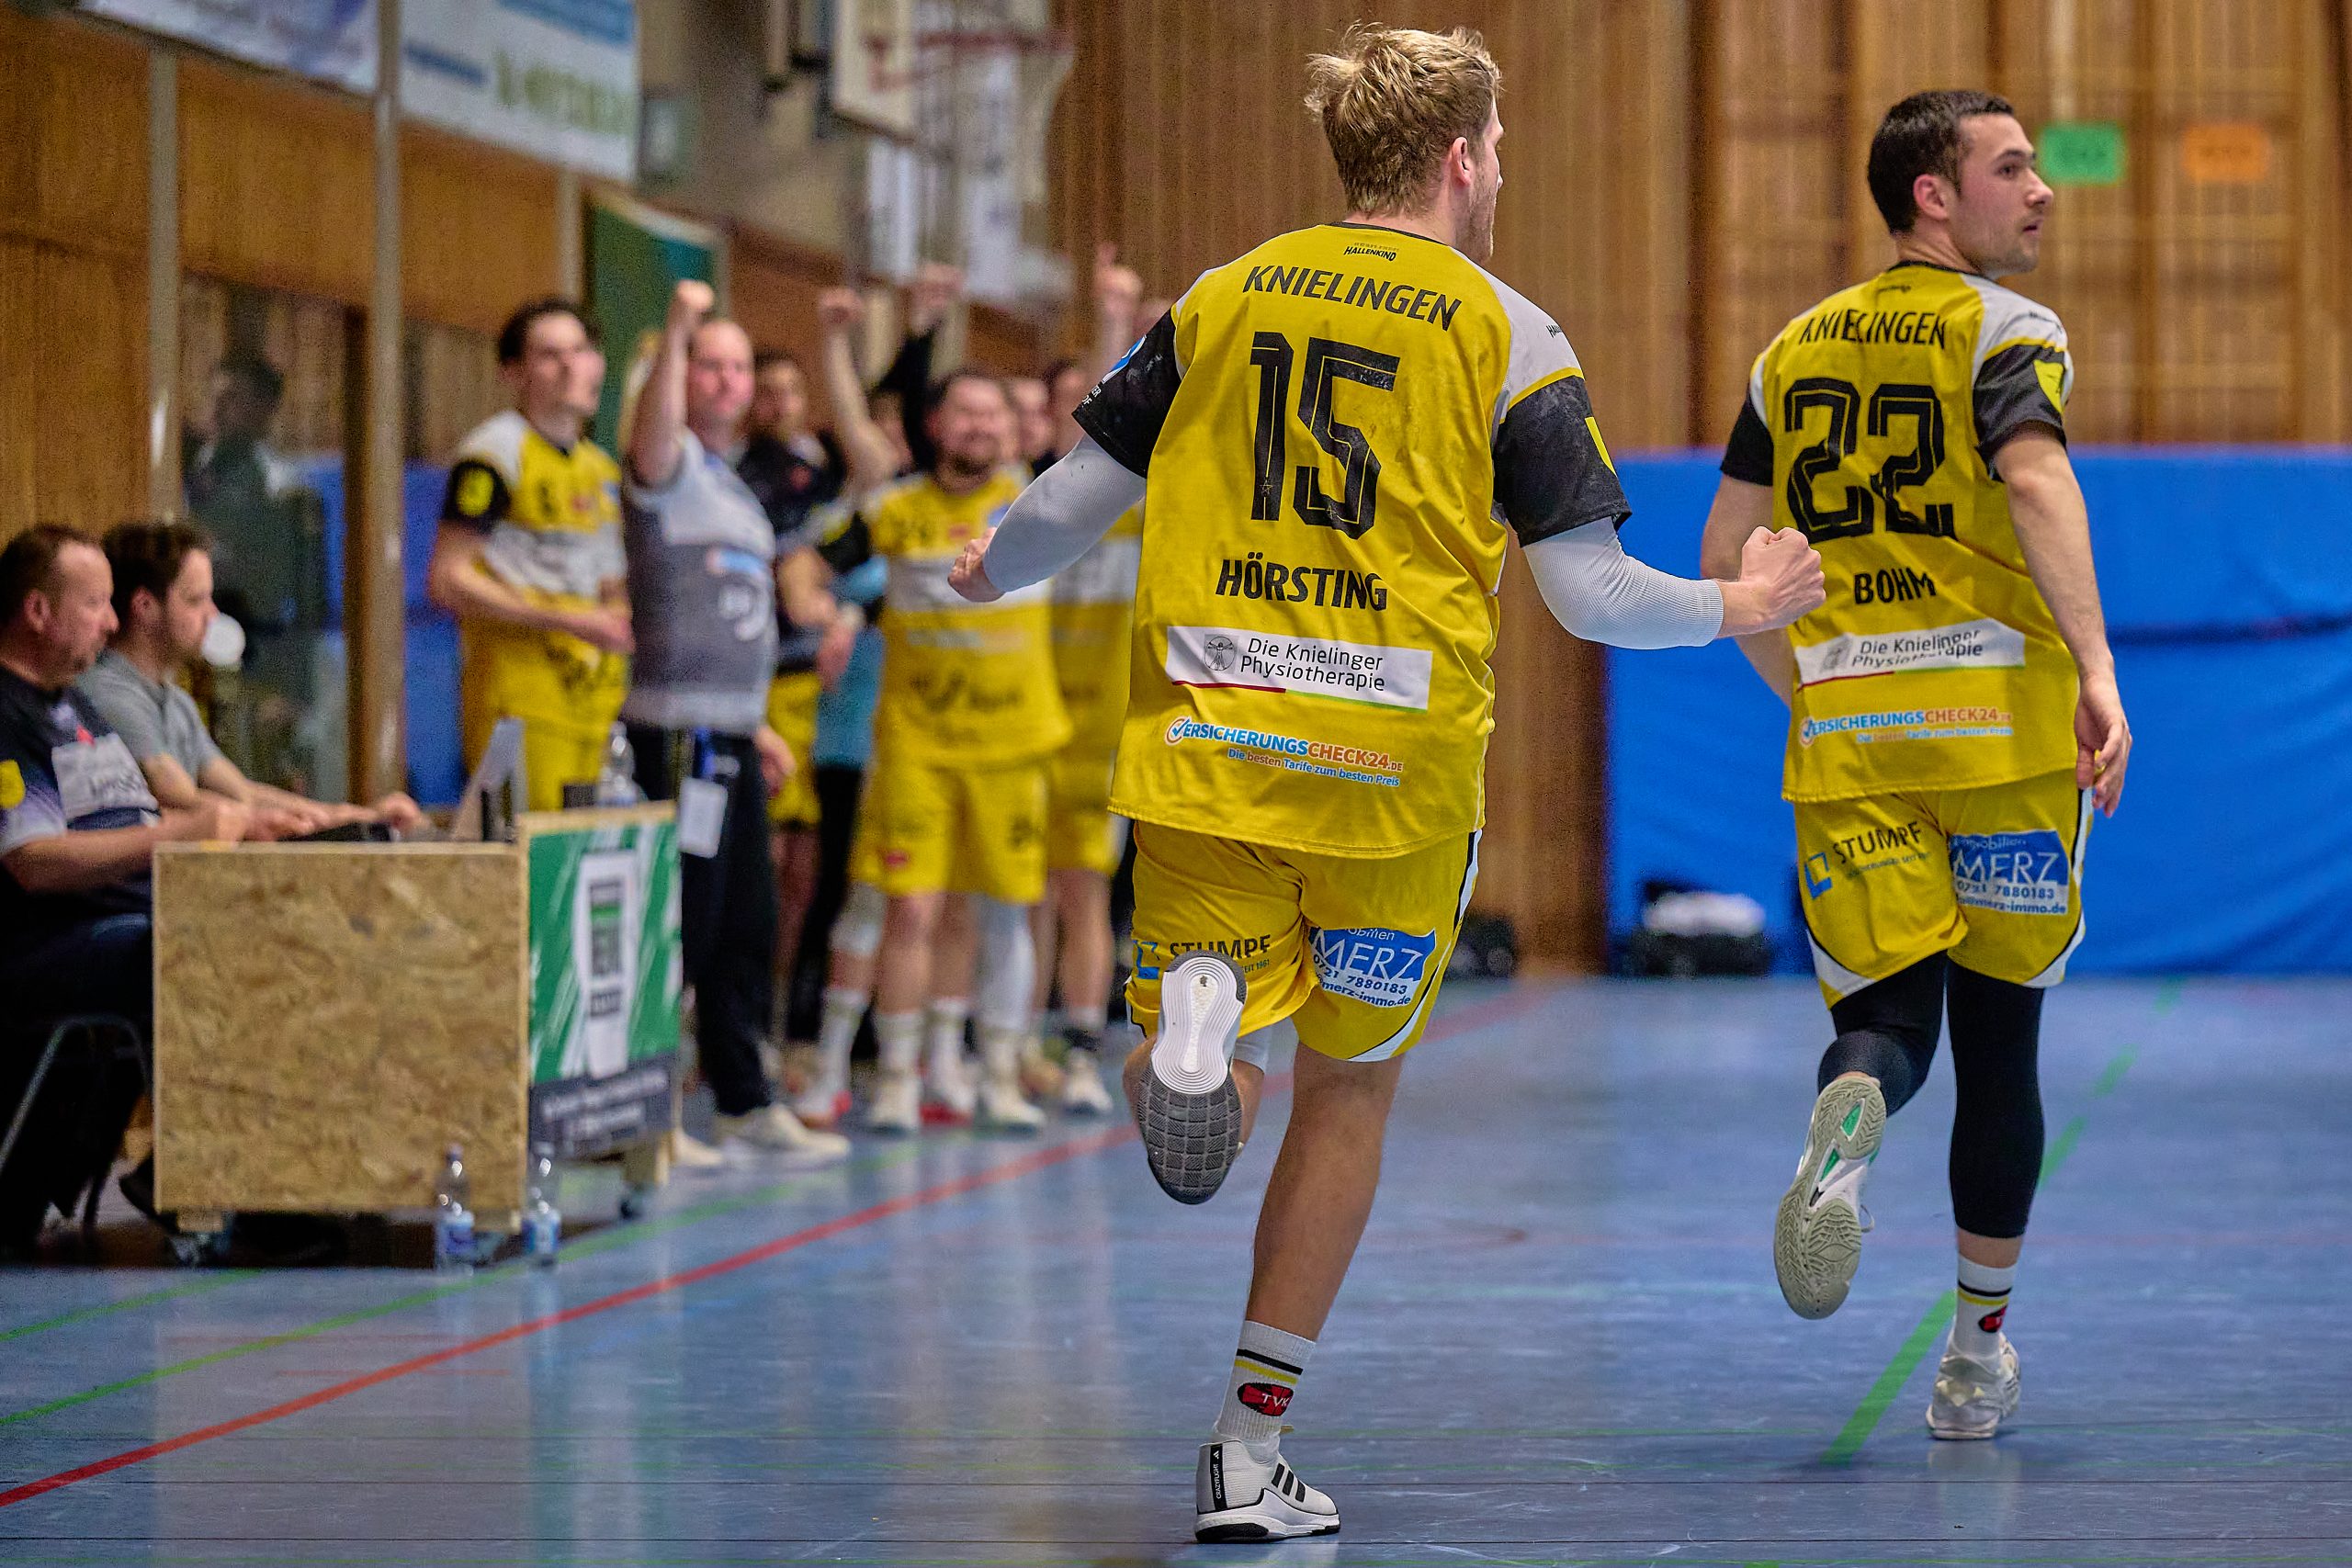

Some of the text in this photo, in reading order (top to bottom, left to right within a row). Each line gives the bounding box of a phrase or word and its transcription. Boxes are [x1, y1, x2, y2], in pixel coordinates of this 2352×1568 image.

[1343, 245, 1396, 262] HALLENKIND
[1243, 265, 1462, 331] KNIELINGEN
[1250, 332, 1400, 540] 15
[1784, 377, 1960, 545] 22
[1216, 552, 1387, 611] HÖRSTING
[1854, 567, 1937, 604] BOHM
[1248, 637, 1383, 670] Die Knielinger
[1852, 644, 1983, 668] Physioapie
[1860, 640, 1888, 654] Die
[1240, 656, 1385, 691] Physiotherapie
[1228, 748, 1399, 787] Die besten Tarife zum besten Preis
[1833, 821, 1920, 863] STUMPF
[1953, 850, 2059, 884] MERZ
[1996, 885, 2054, 899] 7880183
[1347, 929, 1395, 941] obilien
[1311, 929, 1423, 980] MERZ
[1313, 953, 1408, 995] 0721 7880183
[1317, 974, 1411, 1007] @merz-immo.de
[1261, 1393, 1290, 1407] TVK
